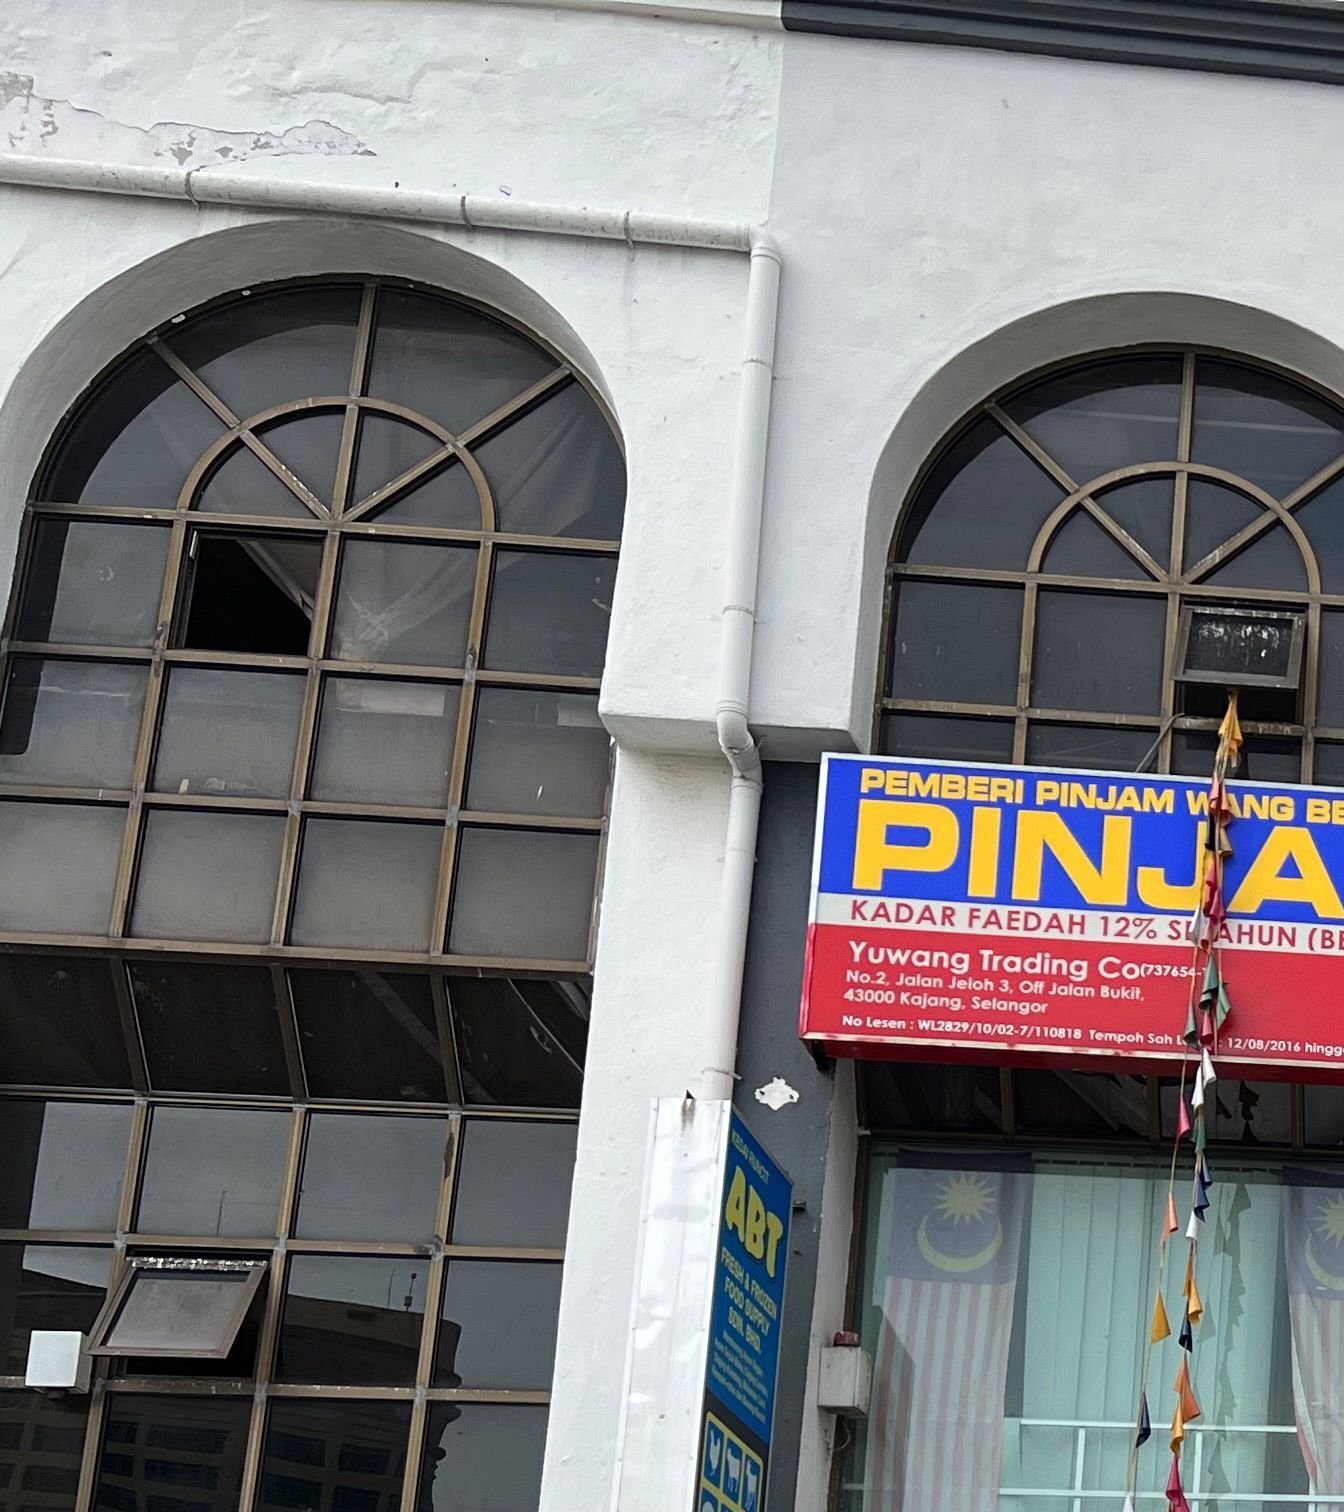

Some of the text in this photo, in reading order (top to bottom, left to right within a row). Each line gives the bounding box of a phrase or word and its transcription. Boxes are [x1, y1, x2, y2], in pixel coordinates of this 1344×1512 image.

[860, 768, 1024, 804] PEMBERI
[1036, 780, 1174, 814] PINJAM
[851, 900, 956, 927] KADAR
[968, 907, 1086, 934] FAEDAH
[1100, 915, 1157, 939] 12%
[849, 940, 970, 975] Yuwang
[979, 949, 1088, 982] Trading
[844, 989, 1048, 1015] 43000 Kajang, Selangor
[846, 970, 1145, 1002] No.2, Jalan Jeloh 3, Off Jalan Bukit,
[842, 1015, 862, 1027] No
[866, 1017, 907, 1030] Lesen
[1089, 1030, 1143, 1045] Tempoh
[1147, 1033, 1172, 1045] Sah
[1227, 1037, 1301, 1053] 12/08/2016
[726, 1165, 784, 1279] ABT
